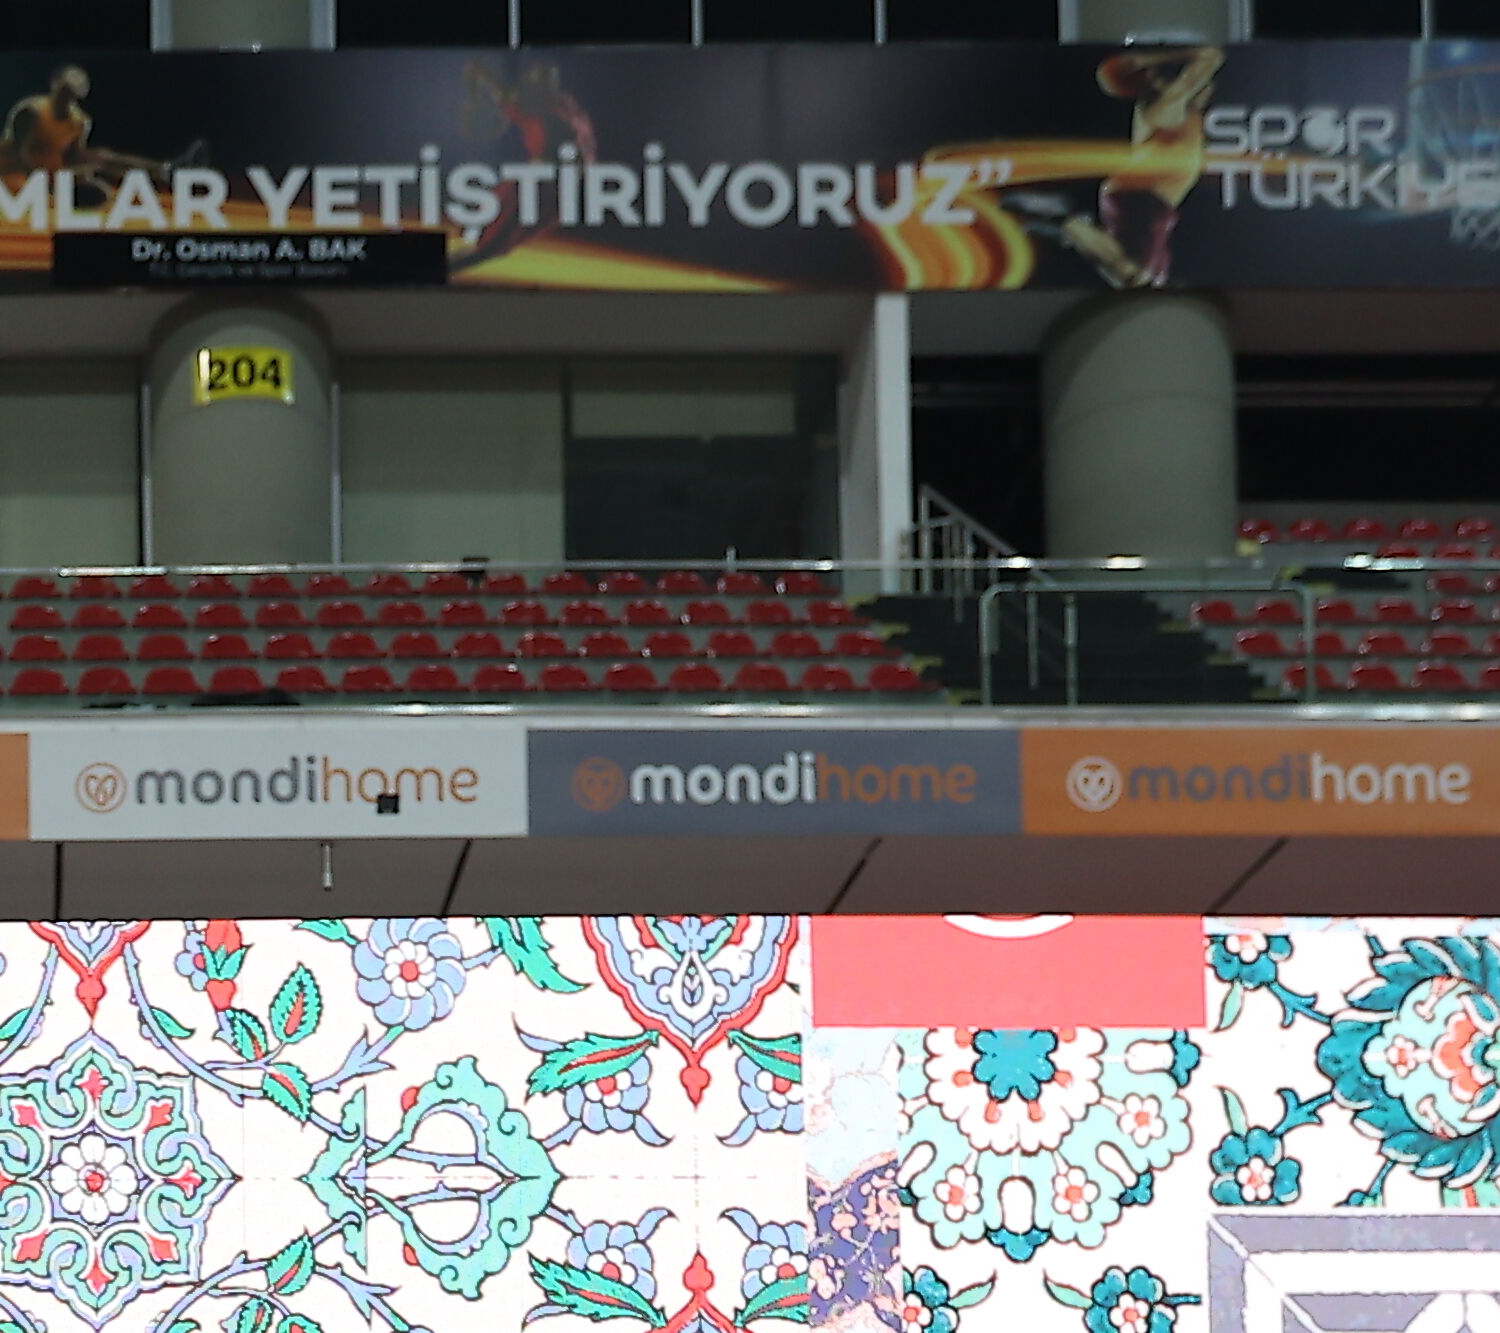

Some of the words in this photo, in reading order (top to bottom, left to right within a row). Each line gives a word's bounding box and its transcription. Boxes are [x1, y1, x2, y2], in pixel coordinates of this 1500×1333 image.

[208, 356, 282, 391] 204
[135, 755, 480, 808] mondihome
[630, 751, 977, 806] mondihome
[1128, 751, 1471, 805] mondihome
